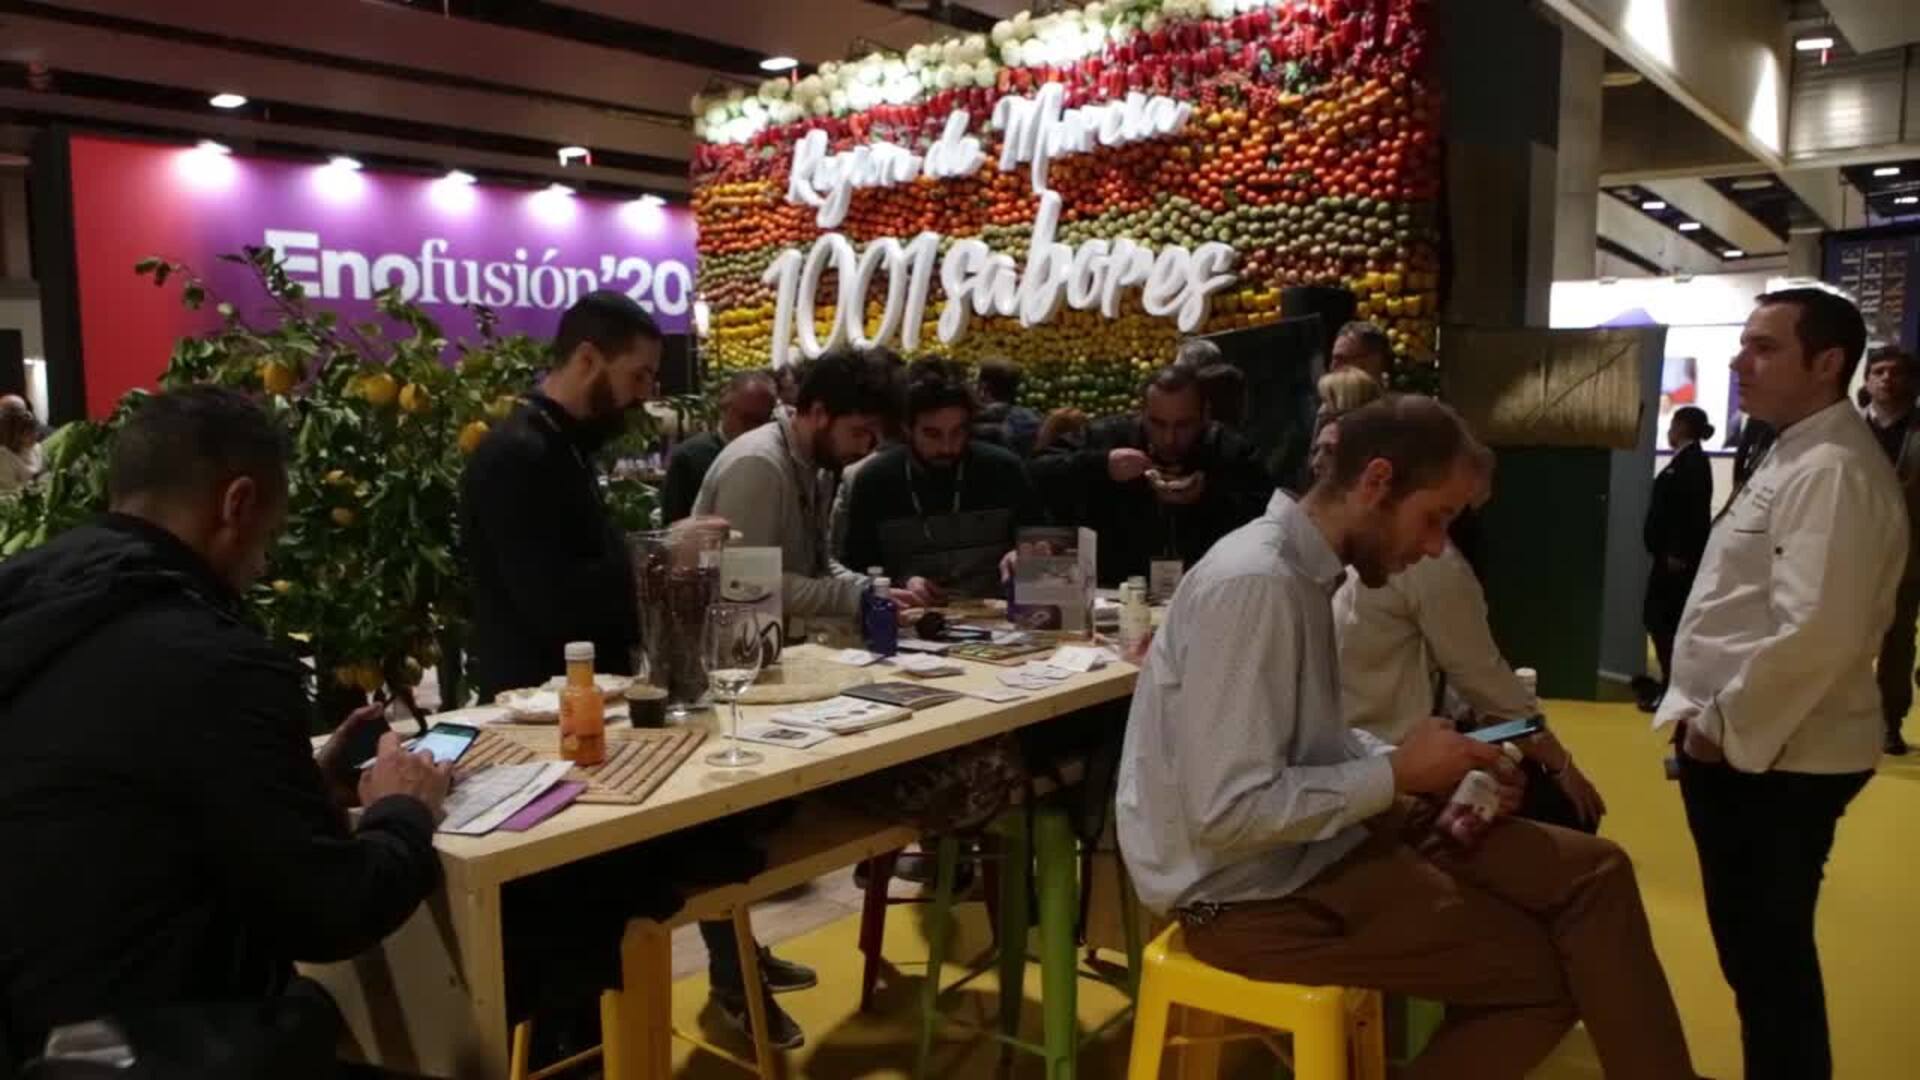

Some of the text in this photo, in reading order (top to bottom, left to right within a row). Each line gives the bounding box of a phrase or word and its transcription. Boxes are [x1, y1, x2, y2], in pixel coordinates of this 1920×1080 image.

[924, 109, 986, 178] de
[992, 81, 1192, 196] Murcia
[762, 189, 1238, 370] 1001 sabores
